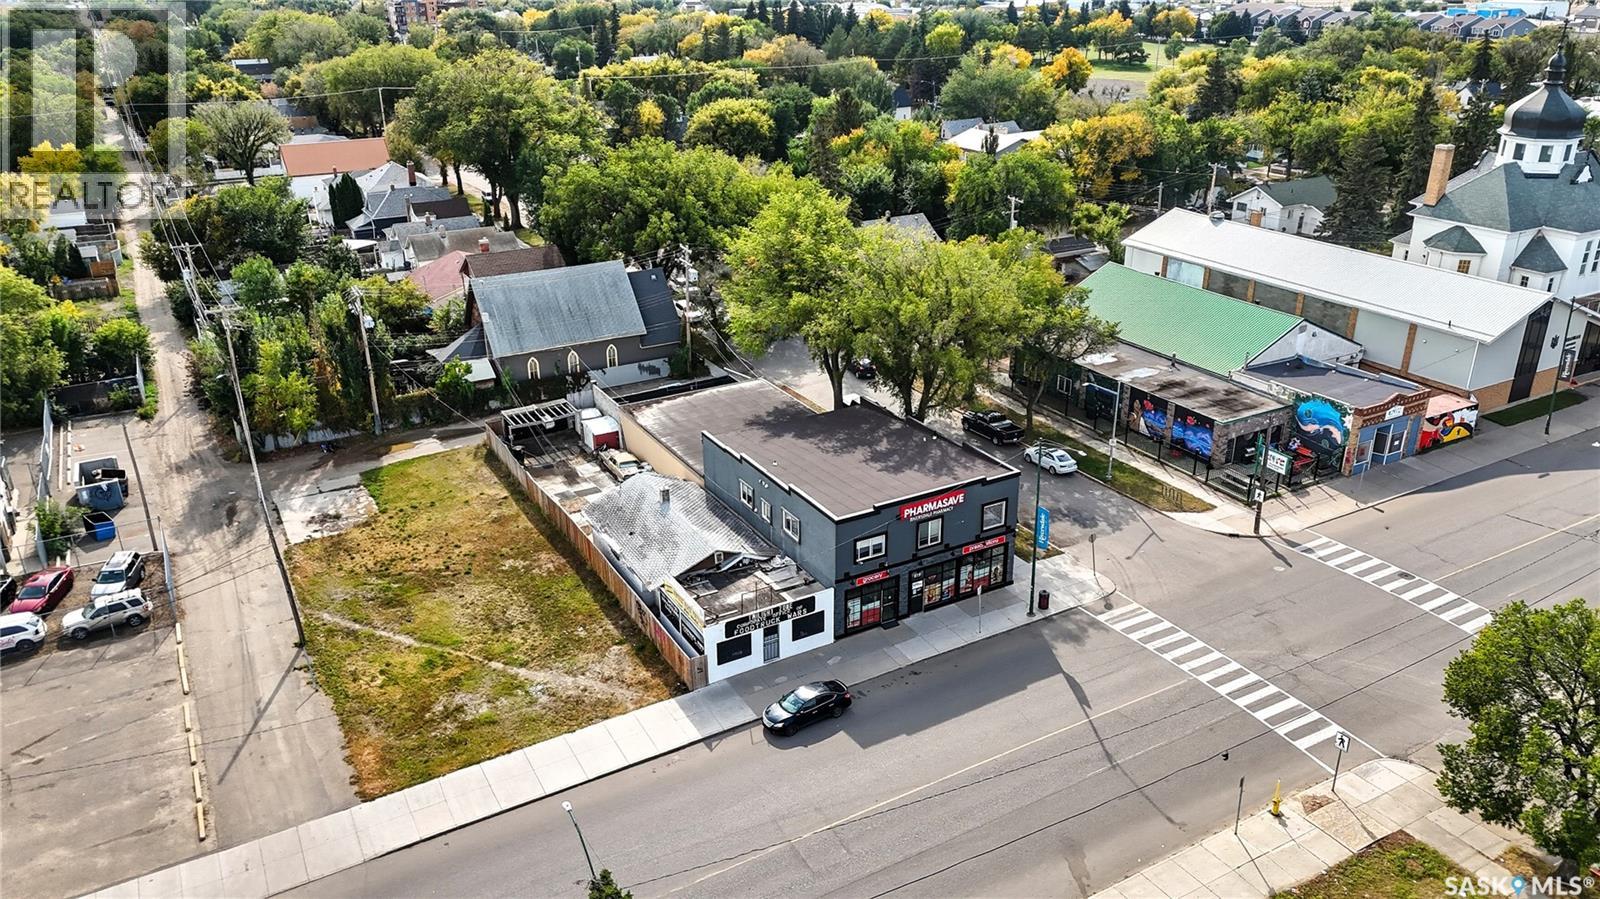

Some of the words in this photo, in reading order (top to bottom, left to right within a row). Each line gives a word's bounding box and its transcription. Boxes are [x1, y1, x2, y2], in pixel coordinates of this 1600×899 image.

[904, 493, 965, 519] PHARMASAVE
[933, 506, 954, 515] PHARMACY
[734, 618, 781, 635] FOODTRUCK
[787, 608, 808, 619] WARS
